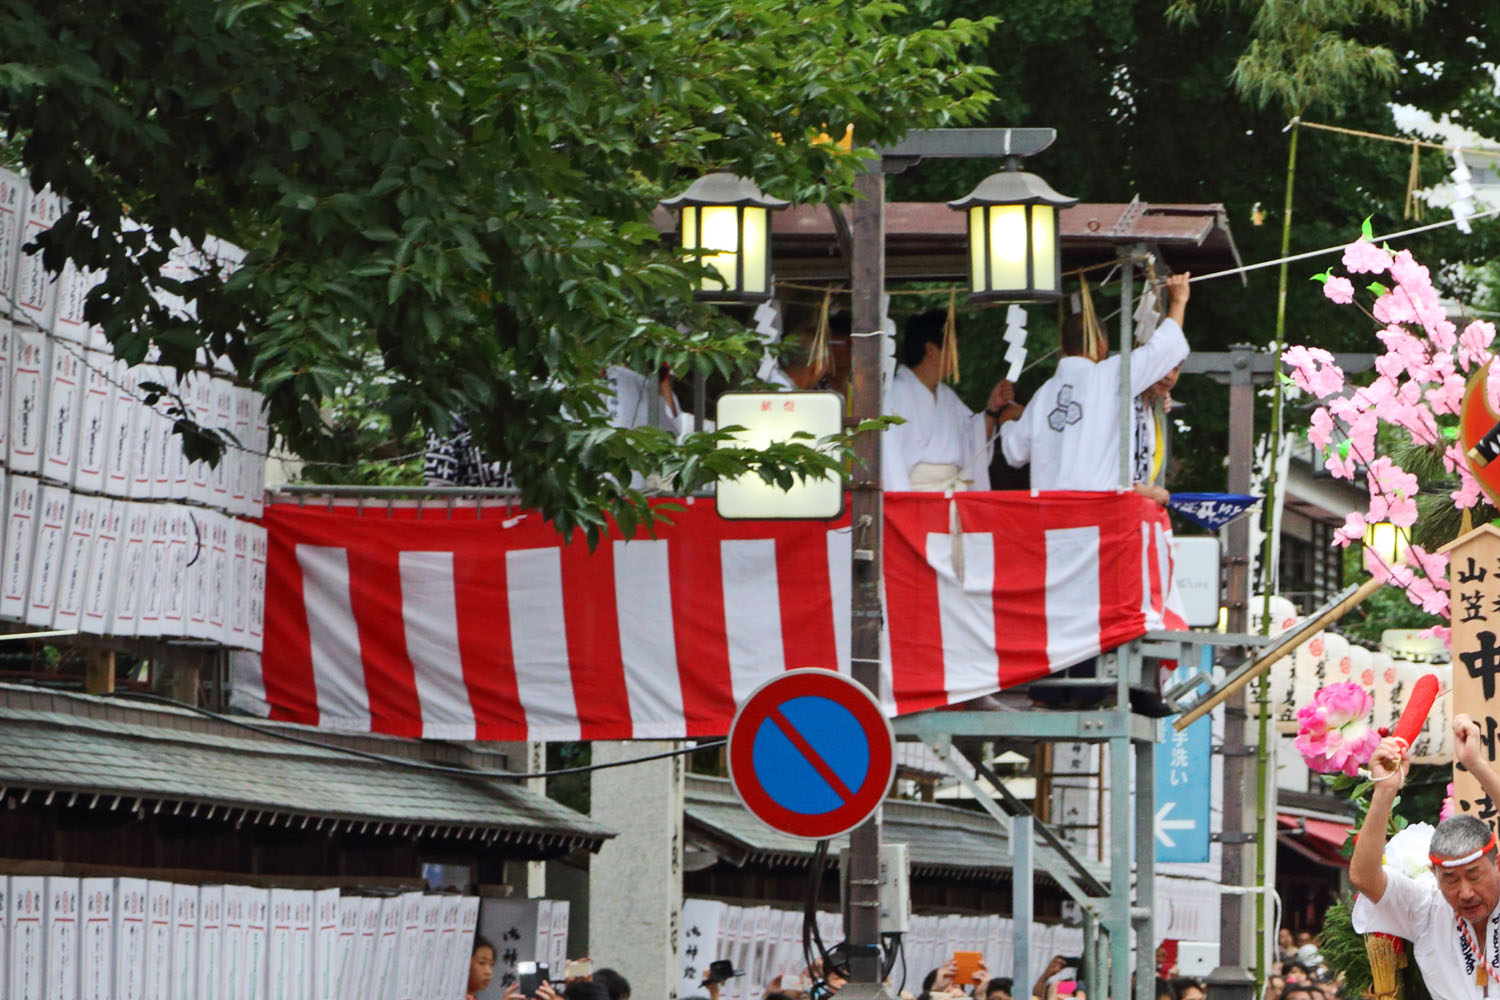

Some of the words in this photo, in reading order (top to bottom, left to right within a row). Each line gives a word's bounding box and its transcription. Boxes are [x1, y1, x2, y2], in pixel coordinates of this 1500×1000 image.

[1457, 557, 1487, 623] 山笠
[1170, 713, 1189, 786] 手洗い
